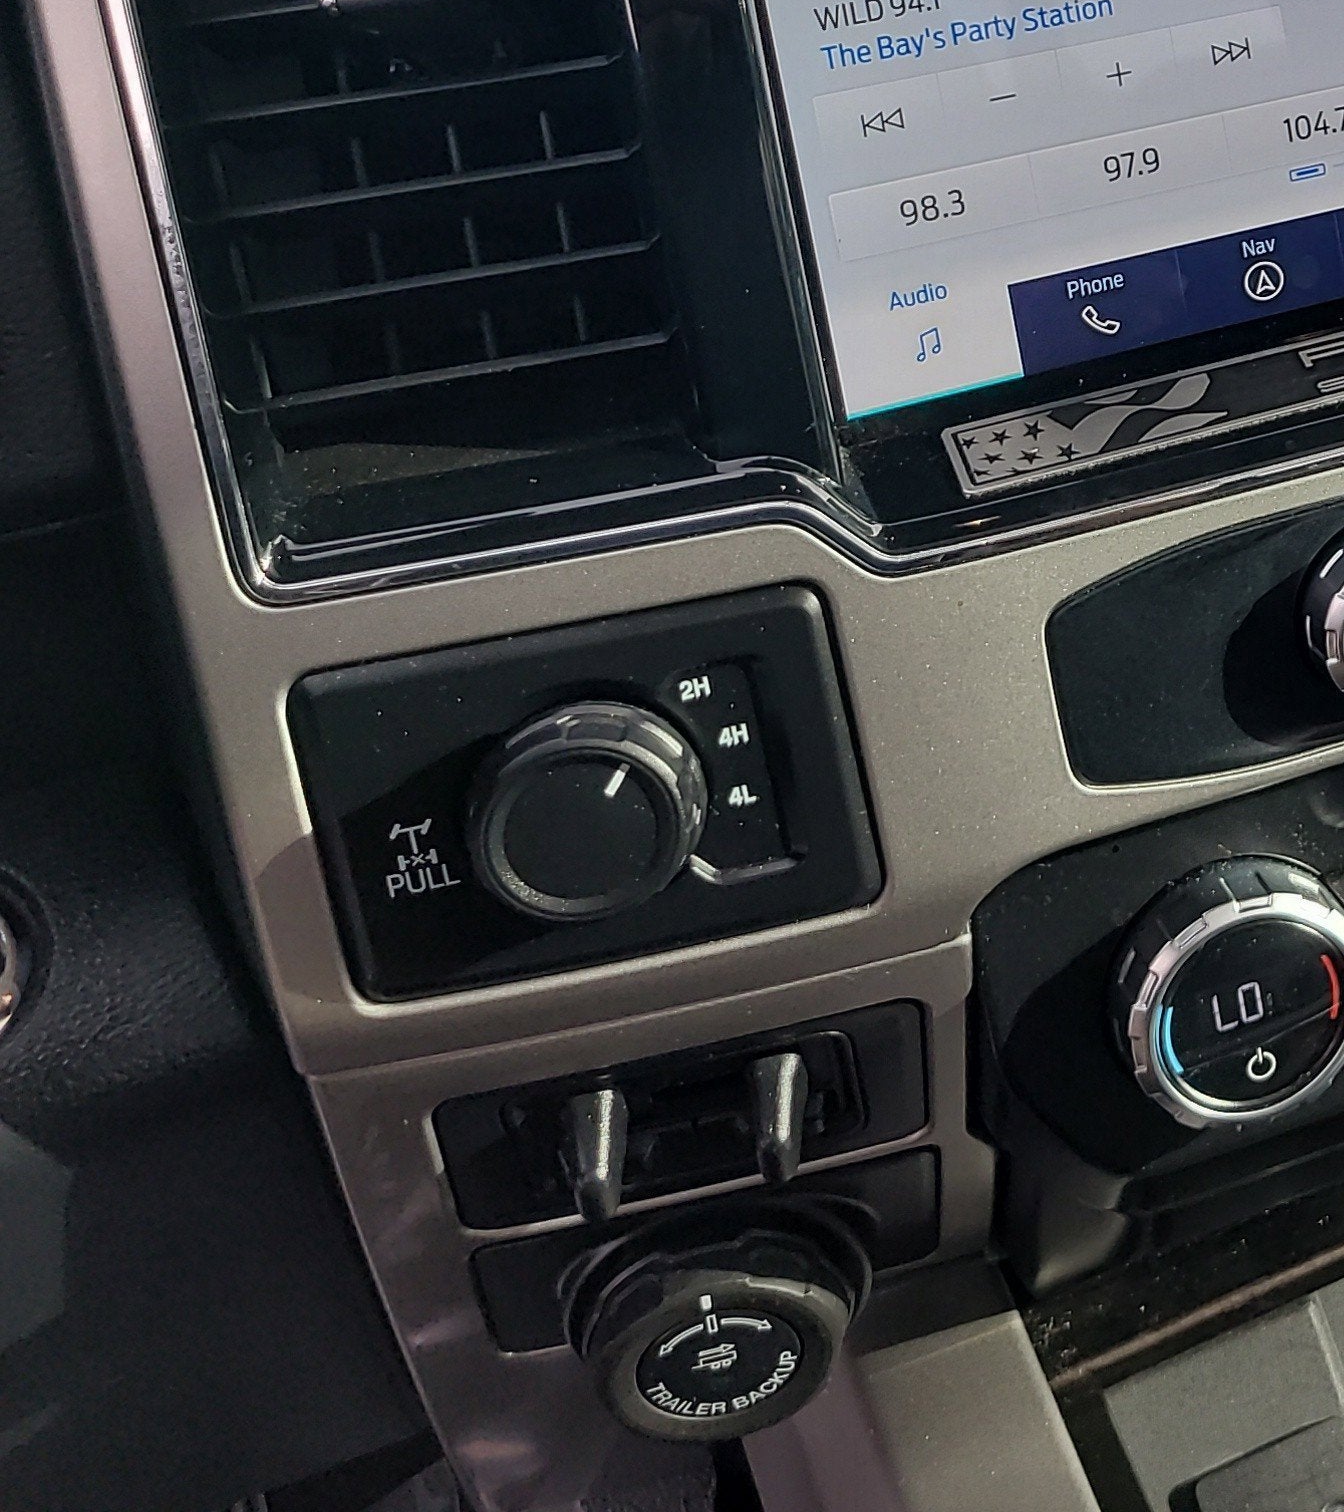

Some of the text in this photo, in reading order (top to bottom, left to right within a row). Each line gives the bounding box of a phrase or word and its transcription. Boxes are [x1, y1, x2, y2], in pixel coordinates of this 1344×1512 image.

[820, 44, 872, 69] The
[877, 27, 946, 60] Bay's
[950, 15, 1016, 45] Party
[1103, 148, 1161, 182] 97.9
[899, 189, 966, 227] 98.3
[1241, 235, 1276, 259] Nav
[889, 281, 948, 311] Audio
[1066, 271, 1125, 299] Phone
[679, 676, 710, 701] 2H
[718, 723, 749, 747] 4H
[728, 784, 757, 807] 4L
[385, 863, 461, 897] PULL
[647, 1351, 798, 1415] TRAILER BACKUP
